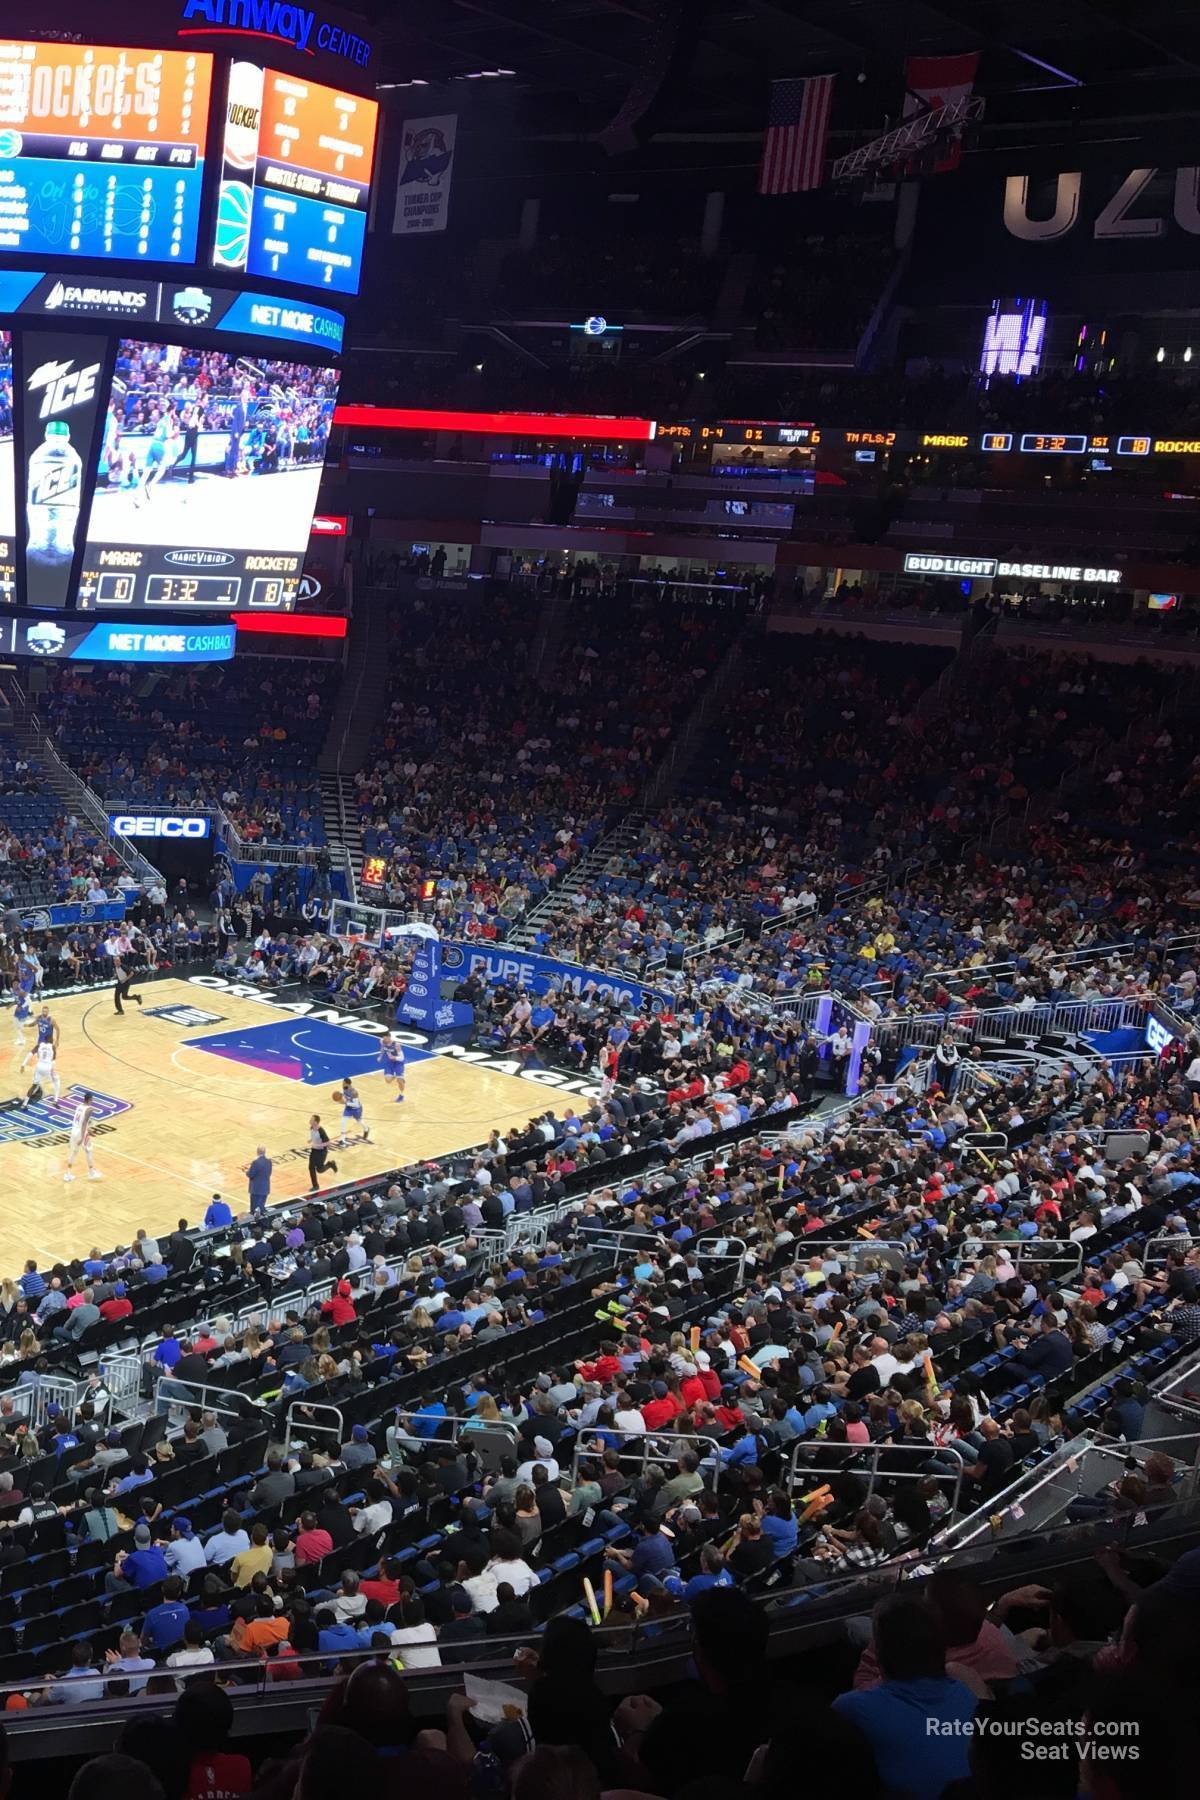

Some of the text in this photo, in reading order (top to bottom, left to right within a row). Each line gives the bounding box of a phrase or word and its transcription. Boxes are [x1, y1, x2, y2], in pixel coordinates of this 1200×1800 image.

[317, 23, 371, 68] CENTER
[63, 286, 147, 307] FAIRWINDS
[64, 302, 100, 310] CREDIT
[251, 304, 333, 336] NET MORE CASH
[39, 363, 100, 418] ICE
[846, 433, 861, 442] TM
[885, 433, 896, 445] 2
[924, 434, 968, 447] MAGIC
[991, 436, 1004, 449] 10
[1035, 437, 1066, 450] 3:32
[1132, 439, 1146, 453] 18
[100, 550, 143, 566] MAGIC
[245, 555, 298, 571] ROCKETS
[908, 557, 1121, 583] BUD LIGHT BASELINE BAR
[114, 578, 128, 598] 10
[160, 580, 199, 601] 3:32
[264, 583, 278, 602] 18
[109, 634, 142, 651] NET
[143, 634, 185, 651] MORE
[186, 635, 210, 651] CASH
[114, 816, 205, 837] GEICO
[471, 954, 535, 986] PURE
[188, 975, 429, 1045] ORLANDO
